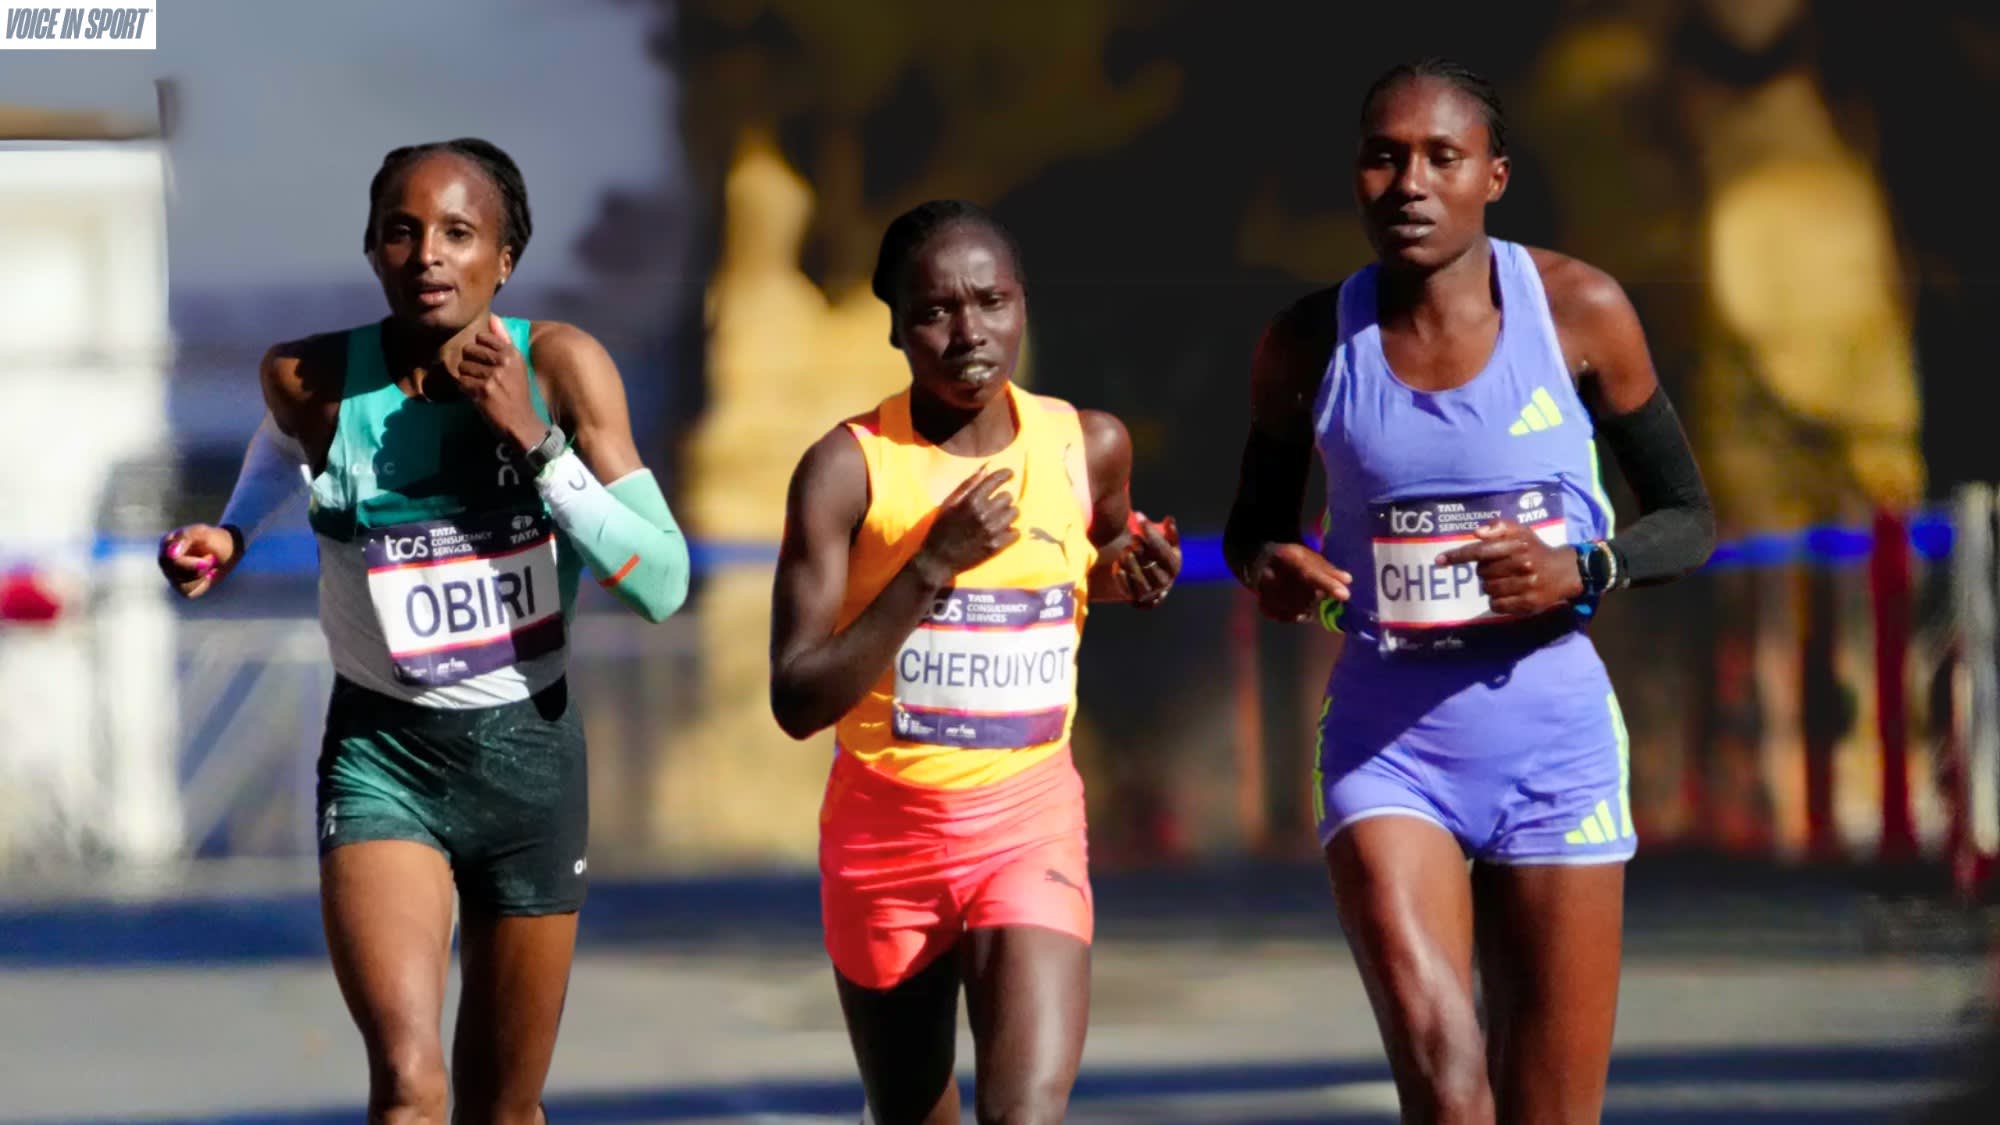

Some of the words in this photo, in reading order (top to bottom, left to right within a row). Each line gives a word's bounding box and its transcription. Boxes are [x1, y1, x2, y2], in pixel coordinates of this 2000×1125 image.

[1438, 503, 1465, 512] TATA
[1391, 506, 1434, 534] tcs
[1438, 510, 1502, 522] CONSULTANCY
[1516, 508, 1548, 523] TATA
[429, 527, 457, 537] TATA
[1438, 521, 1480, 533] SERVICES
[431, 531, 493, 547] CONSULTANCY
[510, 528, 539, 545] TATA
[384, 535, 428, 561] tcs
[432, 543, 473, 557] SERVICES
[406, 566, 536, 638] OBIRI
[900, 646, 1070, 688] CHERUIYOT
